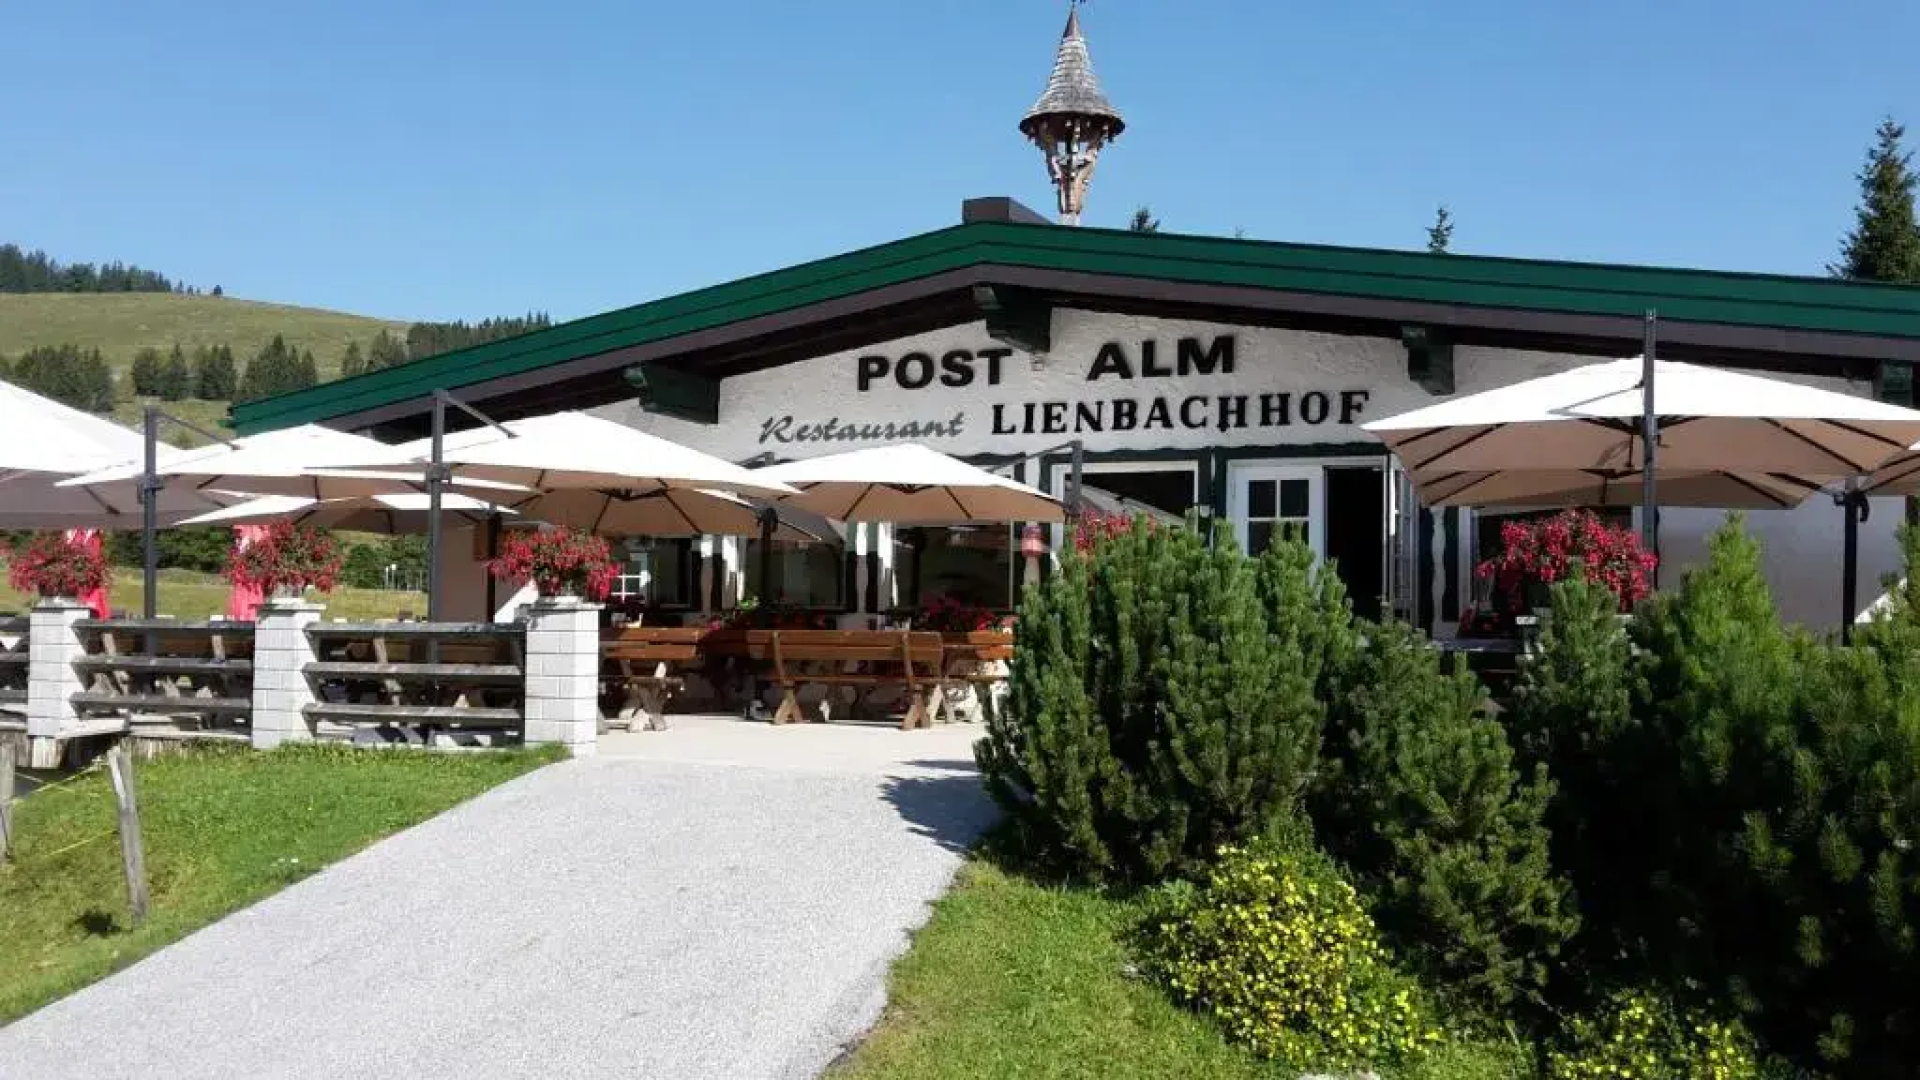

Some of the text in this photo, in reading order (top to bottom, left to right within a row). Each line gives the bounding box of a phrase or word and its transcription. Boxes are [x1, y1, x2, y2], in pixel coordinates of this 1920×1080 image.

[857, 335, 1236, 391] POST ALM
[759, 391, 1370, 444] Restaurant LIENBACHHOF
